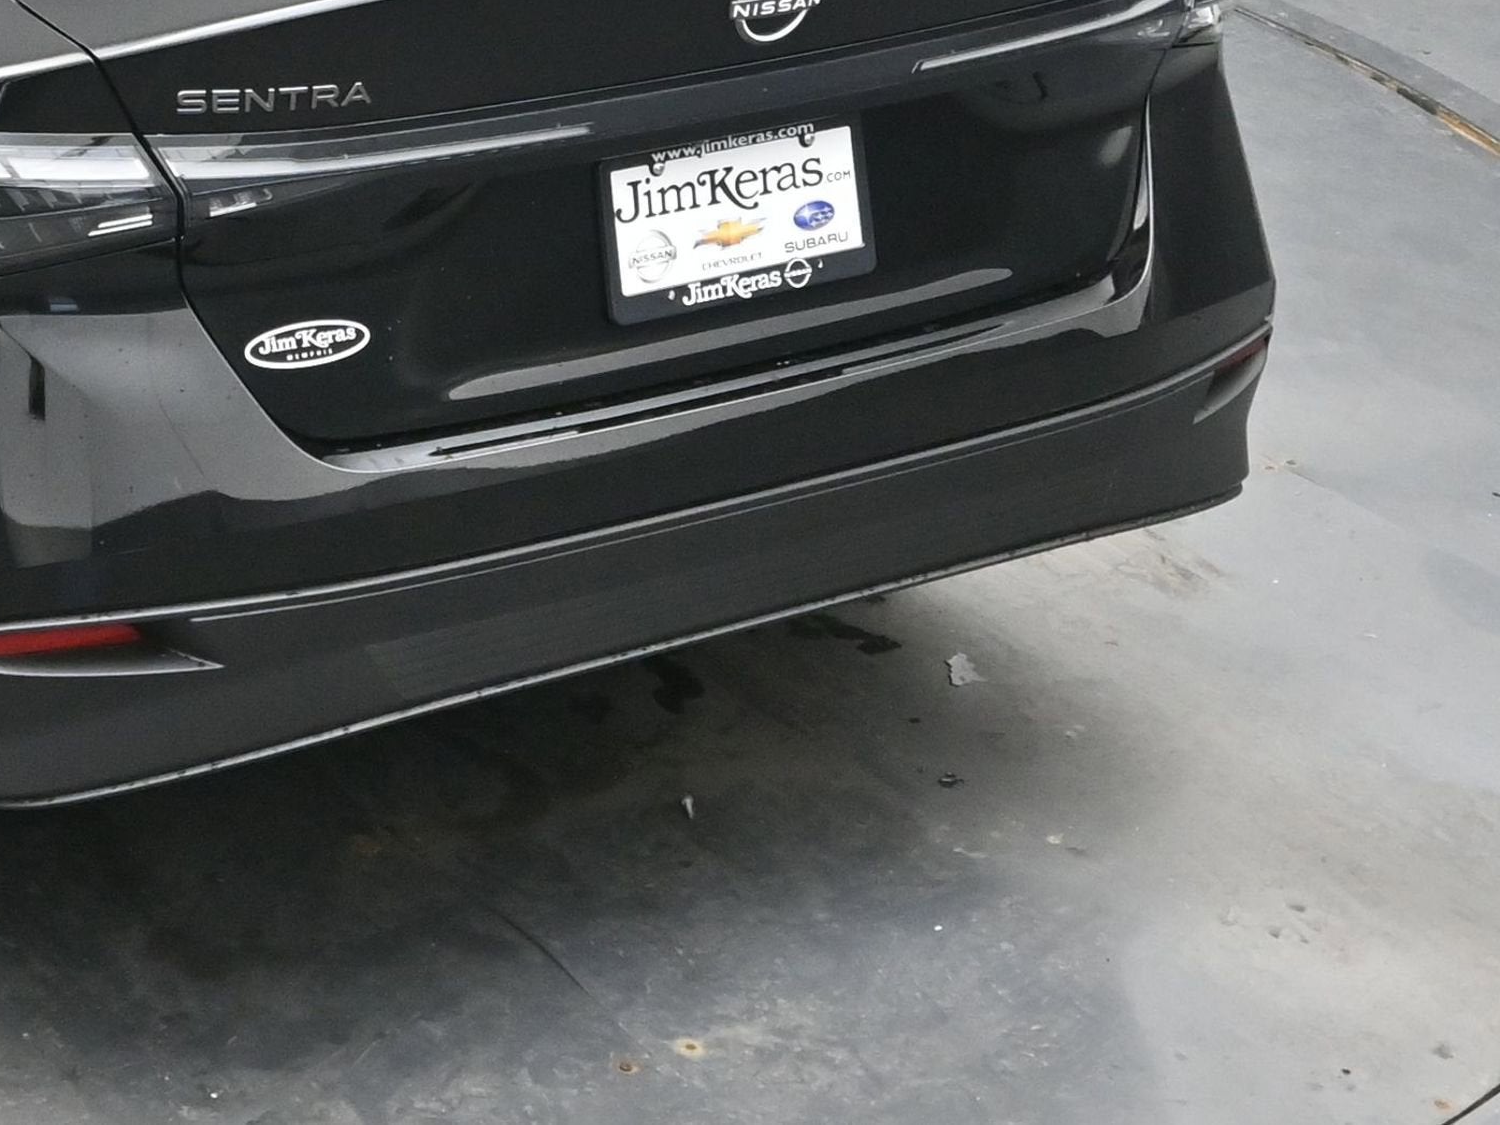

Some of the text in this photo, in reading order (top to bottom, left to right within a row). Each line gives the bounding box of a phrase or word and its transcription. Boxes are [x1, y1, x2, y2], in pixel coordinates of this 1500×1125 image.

[176, 81, 372, 115] SENTRA
[784, 231, 850, 253] SUBARU
[632, 249, 673, 265] NISSAN
